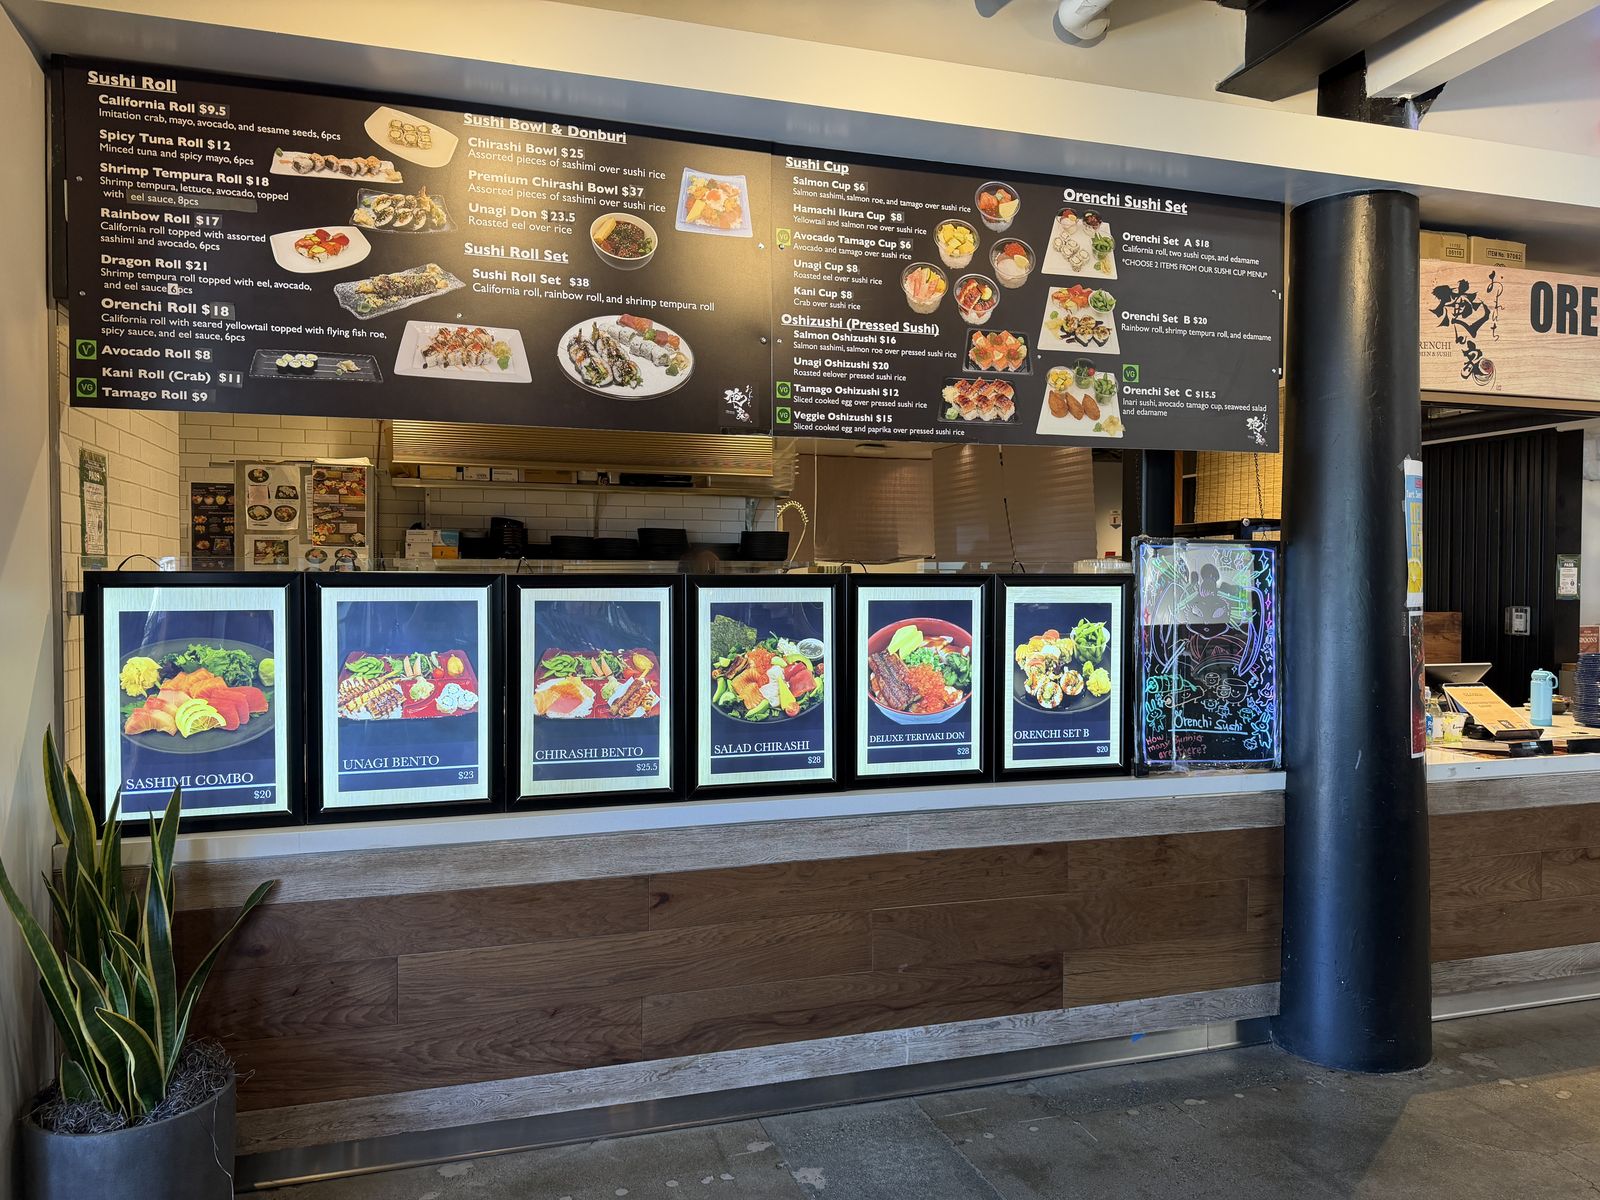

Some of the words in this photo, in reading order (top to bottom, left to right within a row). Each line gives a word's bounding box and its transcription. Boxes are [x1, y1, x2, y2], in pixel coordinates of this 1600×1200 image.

[88, 71, 135, 89] Sushi
[142, 76, 175, 93] Roll
[98, 94, 165, 110] California
[169, 101, 194, 113] Roll
[199, 104, 225, 115] $9.5
[99, 108, 140, 120] Imitation
[144, 114, 166, 123] crab,
[168, 117, 195, 126] mayo,
[197, 119, 236, 130] avocado,
[238, 123, 254, 131] and
[257, 126, 289, 135] sesame
[292, 129, 320, 138] seeds,
[320, 130, 340, 140] 6pcs
[463, 112, 504, 127] Sushi
[510, 119, 545, 134] Bowl
[551, 123, 562, 136] &
[568, 125, 626, 144] Donburi
[99, 129, 135, 144] Spicy
[139, 133, 173, 145] Tuna
[177, 136, 203, 148] Roll
[207, 139, 230, 150] $12
[469, 137, 520, 151] Chirashi
[526, 143, 556, 156] Bowl
[561, 147, 583, 158] $25
[99, 143, 133, 154] Minced
[137, 148, 157, 156] tuna
[160, 149, 176, 158] and
[180, 151, 202, 162] spicy
[205, 155, 232, 163] mayo,
[233, 155, 253, 165] 6pcs
[786, 156, 819, 171] Sushi
[823, 161, 849, 175] Cup
[793, 176, 828, 187] Salmon
[831, 180, 850, 192] Cup
[853, 182, 865, 191] $6
[1063, 188, 1119, 207] Orenchi
[1124, 195, 1160, 212] Sushi
[1165, 199, 1187, 215] Set
[469, 202, 505, 217] Unagi
[511, 207, 536, 218] Don
[540, 209, 575, 222] $23.5
[468, 215, 508, 228] Roasted
[511, 220, 525, 229] eel
[528, 224, 551, 232] over
[554, 224, 572, 234] rice
[793, 233, 834, 242] Avocado
[838, 235, 875, 248] Tamago
[877, 238, 896, 250] Cup
[899, 240, 911, 249] $6
[1122, 231, 1160, 244] Orenchi
[1163, 236, 1179, 245] Set
[1184, 238, 1191, 247] A
[1195, 239, 1209, 247] $18
[464, 242, 504, 258] Sushi
[510, 246, 538, 261] Roll
[544, 249, 568, 263] Set
[1122, 244, 1153, 254] California
[1155, 248, 1168, 256] roll,
[1200, 253, 1216, 261] cups,
[1230, 255, 1259, 265] edamame
[101, 254, 150, 268] Dragon
[155, 258, 180, 269] Roll
[185, 260, 206, 270] $21
[103, 280, 121, 289] and
[124, 282, 138, 290] eel
[472, 268, 506, 280] Sushi
[511, 271, 535, 282] Roll
[540, 274, 561, 285] Set
[569, 277, 589, 287] $38
[794, 286, 815, 295] Kani
[818, 288, 837, 299] Cup
[840, 290, 852, 299] $8
[101, 297, 161, 311] Orenchi
[167, 301, 196, 313] Roll
[201, 304, 228, 316] $18
[793, 297, 810, 306] Crab
[847, 302, 860, 310] rice
[781, 314, 842, 329] Oshizushi
[846, 318, 899, 332] (Pressed
[903, 322, 939, 336] Sushi)
[793, 330, 829, 340] Salmon
[831, 332, 876, 343] Oshizushi
[879, 335, 896, 344] $16
[101, 345, 160, 357] Avocado
[165, 348, 190, 358] Roll
[194, 349, 210, 360] $8
[102, 387, 156, 400] Tamago
[161, 389, 187, 399] Roll
[191, 392, 207, 402] $9
[794, 383, 832, 395] Tamago
[834, 385, 879, 395] Oshizushi
[882, 388, 899, 396] $12
[1123, 385, 1160, 395] Orenchi
[1164, 387, 1179, 396] Set
[1185, 388, 1192, 397] C
[1195, 390, 1215, 398] $15.5
[1122, 407, 1134, 415] and
[1136, 408, 1167, 416] edamame
[1174, 711, 1212, 728] Orenchi
[1214, 719, 1243, 731] Sushi
[869, 733, 903, 744] DELUXE
[905, 732, 945, 742] TERIYAKI
[946, 731, 965, 740] DON
[1014, 729, 1061, 740] ORENCHI
[1063, 728, 1081, 738] SET
[1083, 728, 1090, 738] B
[1146, 735, 1164, 745] How
[535, 748, 598, 761] CHIRASHI
[601, 746, 644, 758] BENTO
[714, 743, 752, 755] SALAD
[754, 740, 810, 753] CHIRASHI
[957, 747, 970, 755] $28
[1096, 745, 1109, 753] $20
[343, 756, 389, 770] UNAGI
[392, 755, 440, 768] BENTO
[636, 762, 658, 772] $25.5
[807, 756, 821, 765] $28
[126, 775, 192, 789] SASHIMI
[195, 773, 254, 786] COMBO
[458, 770, 474, 780] $23
[253, 790, 272, 799] $20
